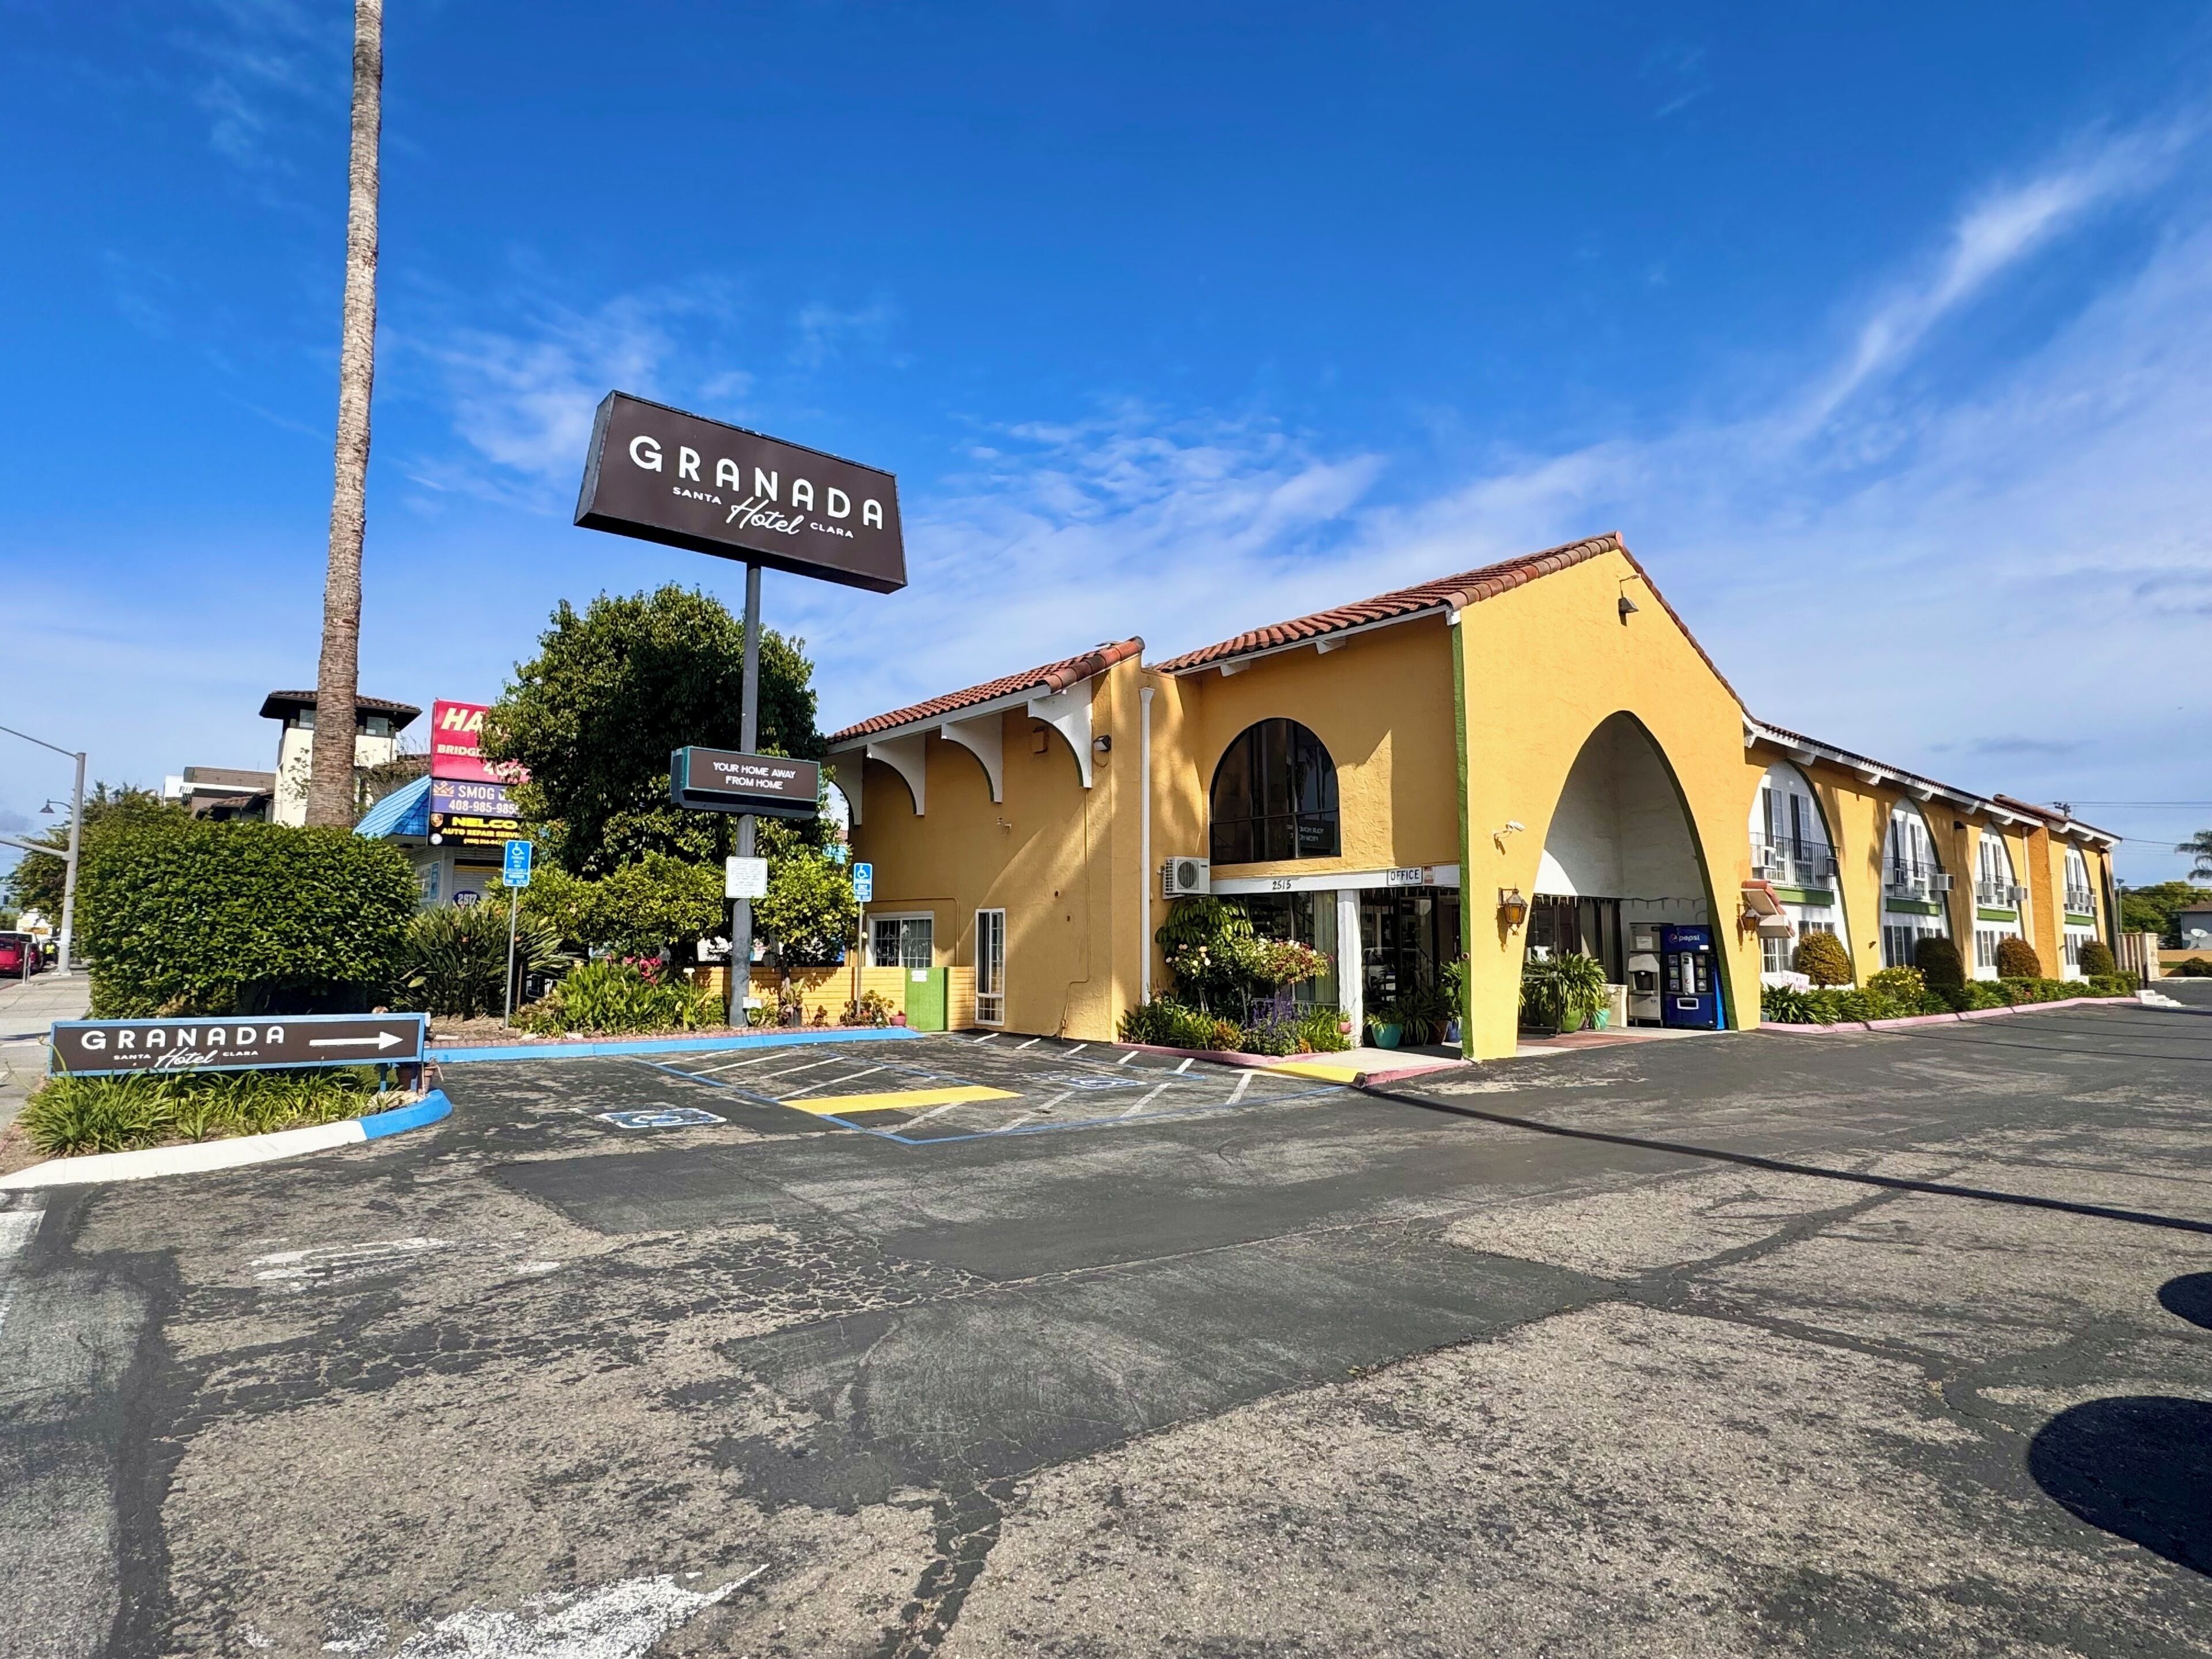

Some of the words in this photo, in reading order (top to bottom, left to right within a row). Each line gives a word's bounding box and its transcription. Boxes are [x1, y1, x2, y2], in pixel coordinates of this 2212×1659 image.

[629, 435, 883, 531] GRANADA
[673, 487, 722, 505] SANTA
[726, 496, 805, 535] Hotel
[810, 522, 854, 539] CLARA
[713, 762, 739, 774] YOUR
[741, 764, 769, 777] HOME
[771, 768, 797, 779] AWAY
[725, 775, 754, 787] FROM
[756, 778, 783, 790] HOME
[458, 785, 495, 800] SMOG
[452, 816, 518, 830] NELCO
[441, 828, 465, 836] AUTO
[1391, 869, 1419, 881] OFFICE
[1272, 879, 1291, 891] 2515
[458, 893, 478, 905] 2517
[1679, 934, 1700, 942] pepsi
[81, 1025, 285, 1050] GRANADA
[153, 1047, 218, 1069] Hotel
